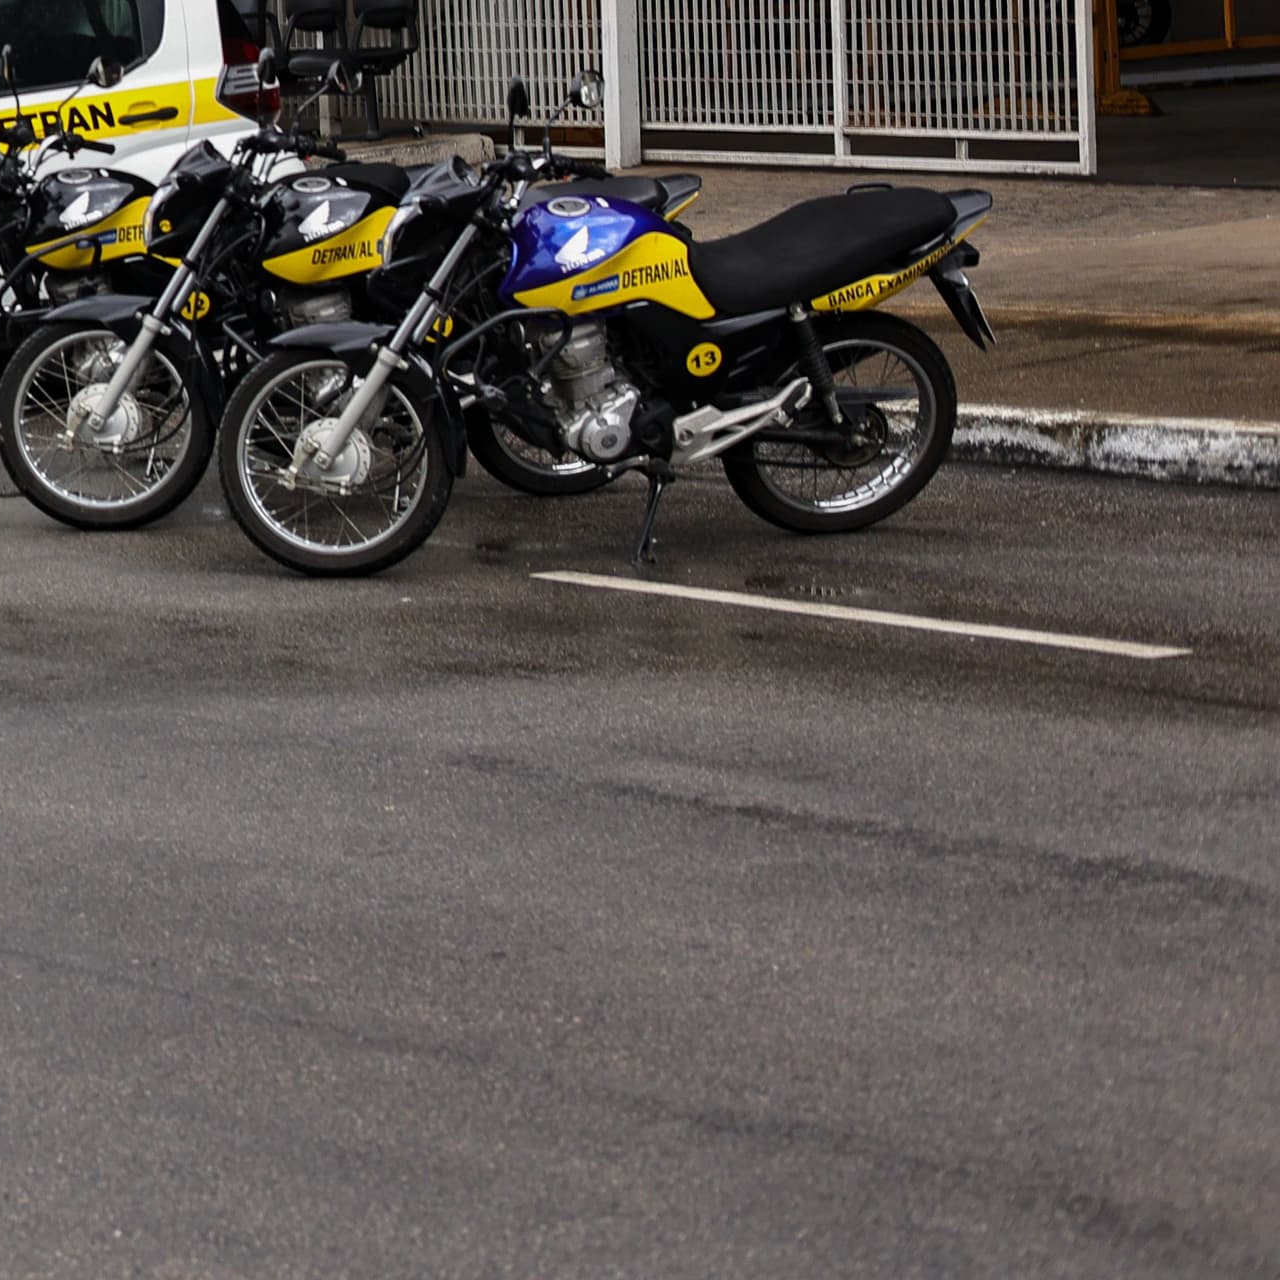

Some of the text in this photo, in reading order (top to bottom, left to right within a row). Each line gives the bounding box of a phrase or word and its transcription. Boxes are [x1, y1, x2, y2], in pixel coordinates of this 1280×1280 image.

[312, 240, 373, 265] DETRAN/AL
[622, 258, 689, 289] DETRAN/AL
[828, 283, 875, 308] BANCA
[691, 351, 717, 369] 13
